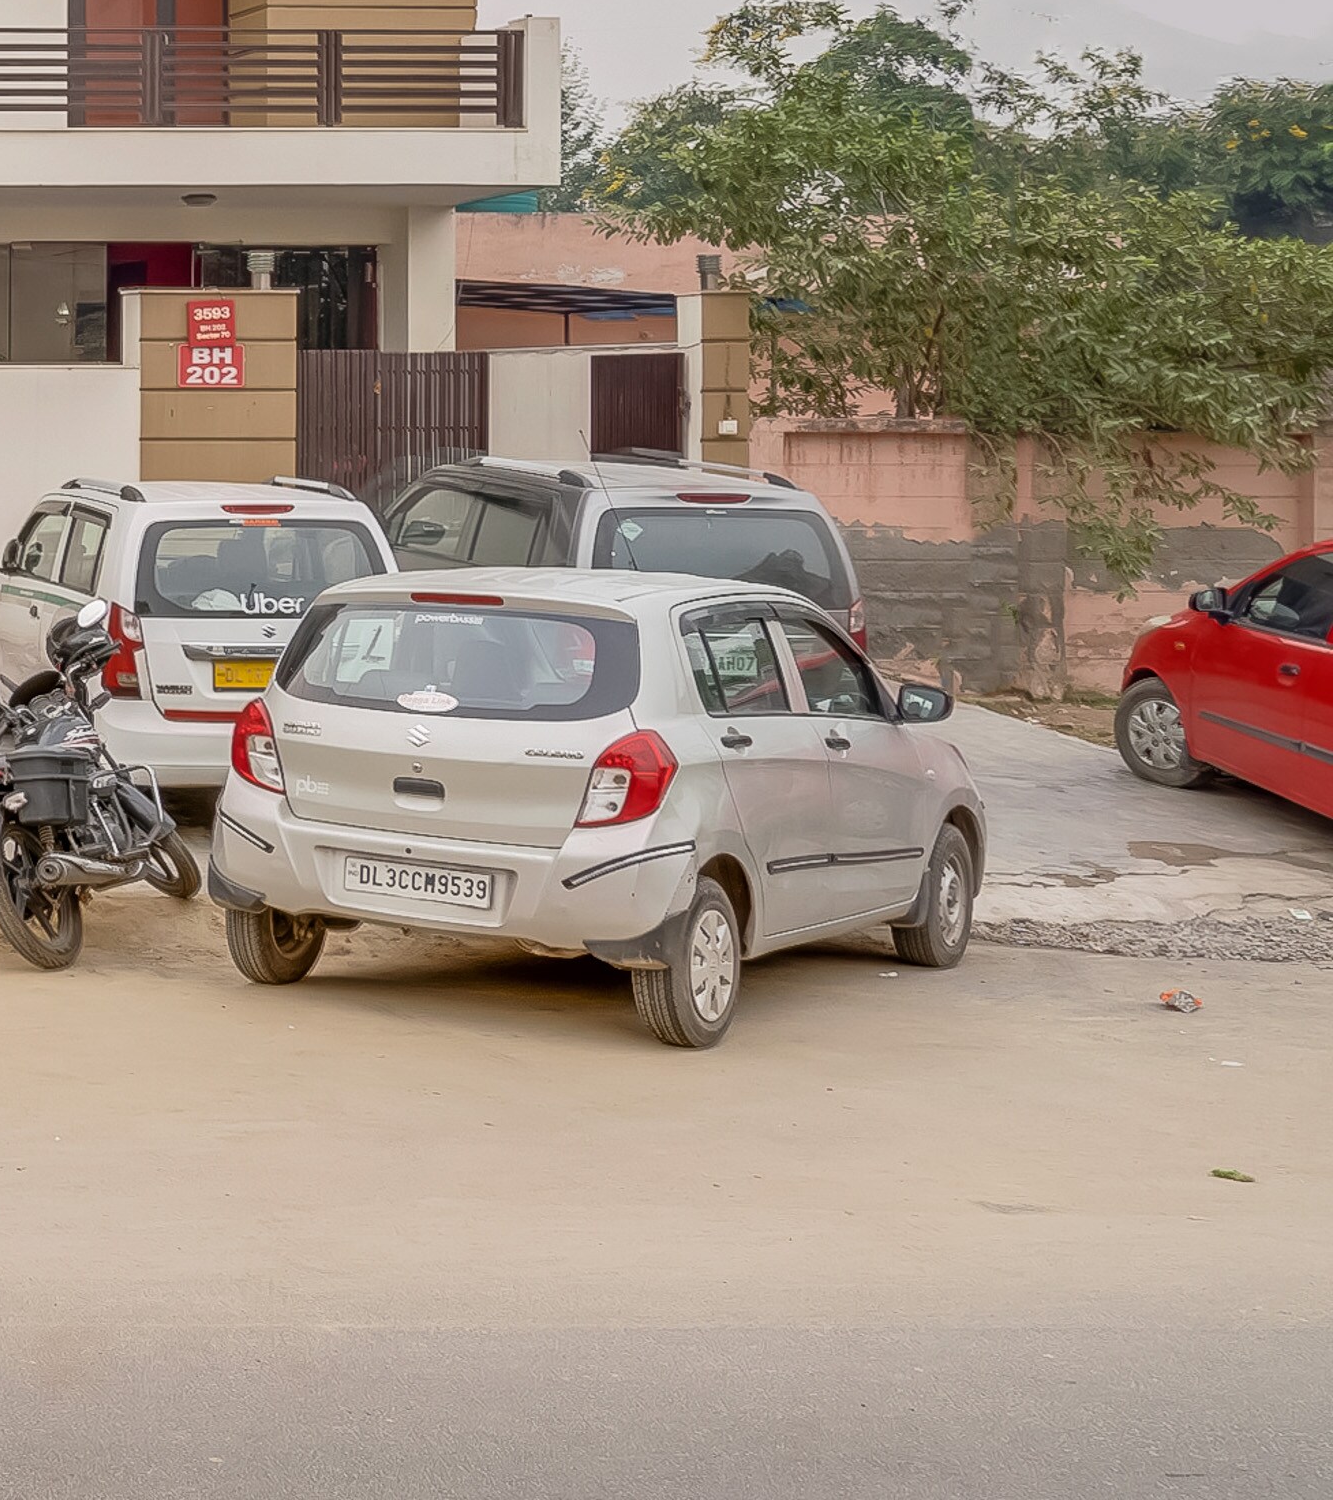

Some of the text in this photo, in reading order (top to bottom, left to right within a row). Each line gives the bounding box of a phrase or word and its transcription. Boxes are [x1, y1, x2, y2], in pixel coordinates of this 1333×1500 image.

[193, 306, 231, 321] 3593
[191, 346, 233, 364] BH
[185, 366, 239, 385] 202
[239, 592, 305, 615] Uber
[359, 863, 488, 900] DL3CCM9539
